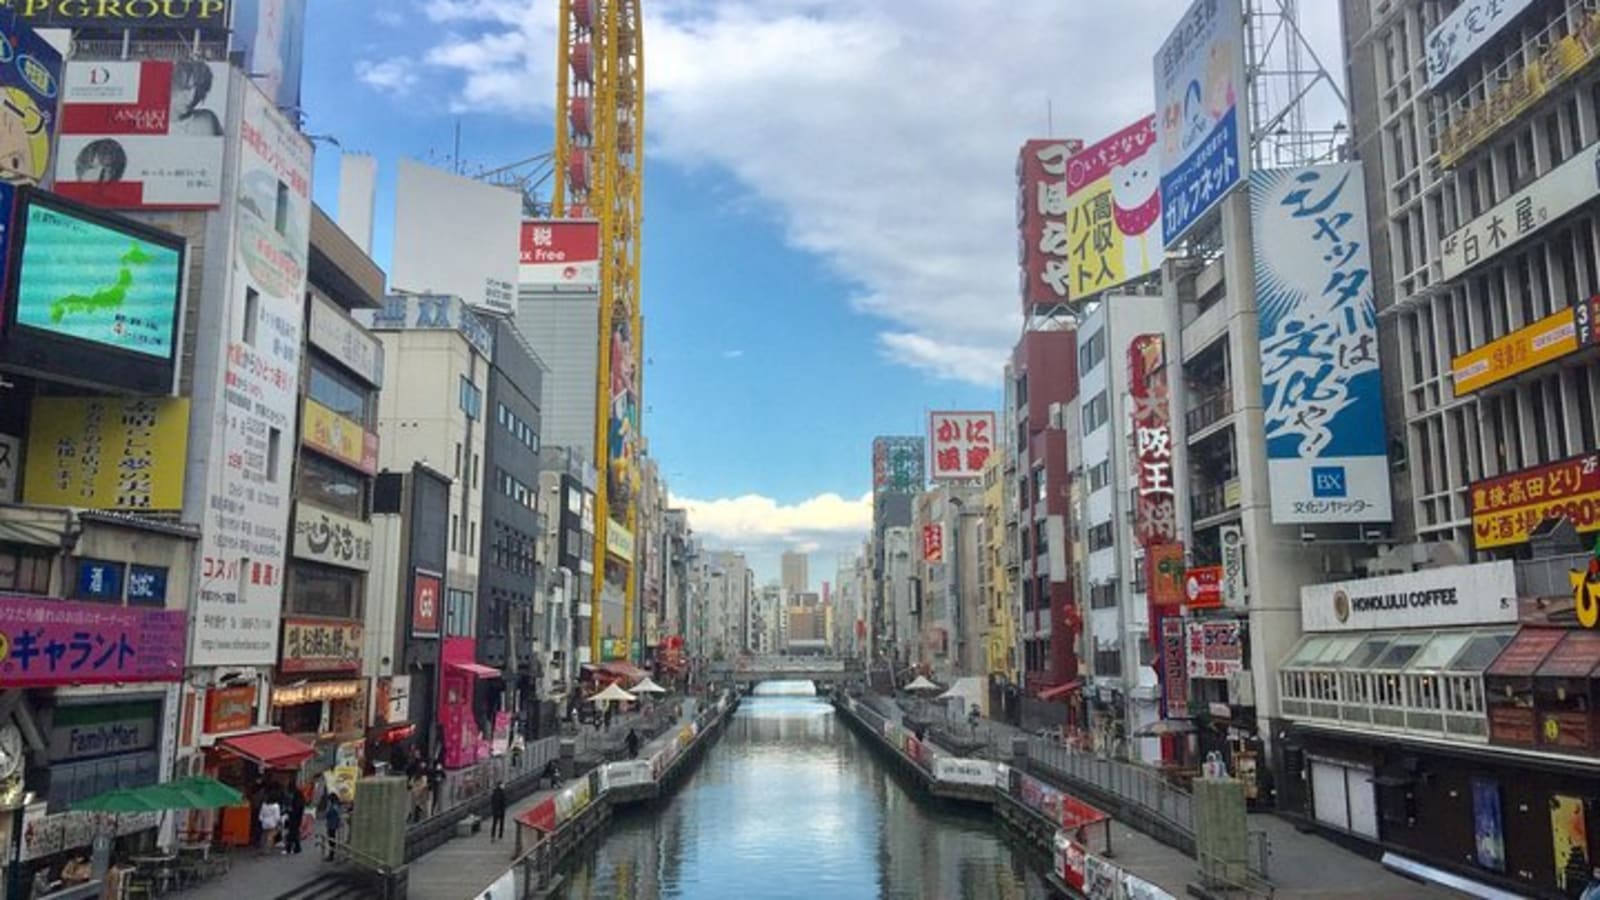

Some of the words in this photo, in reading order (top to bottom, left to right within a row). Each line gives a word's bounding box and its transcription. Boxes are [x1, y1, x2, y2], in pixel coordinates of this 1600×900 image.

[57, 0, 223, 18] GROUP
[1166, 146, 1235, 237] ガルフネット
[1093, 189, 1114, 286] 高収入
[1463, 196, 1537, 265] 白木屋
[535, 248, 566, 261] Free
[936, 419, 989, 443] かに
[1317, 473, 1342, 491] BX
[1473, 466, 1581, 510] 豊後高田どり
[1581, 455, 1598, 474] 2F
[1491, 509, 1537, 540] 酒場
[203, 557, 238, 580] コスパ
[1351, 592, 1408, 612] HONOLULU
[1408, 587, 1460, 607] COFFEE
[11, 627, 136, 672] ギャラント
[70, 726, 139, 750] FamilyMart
